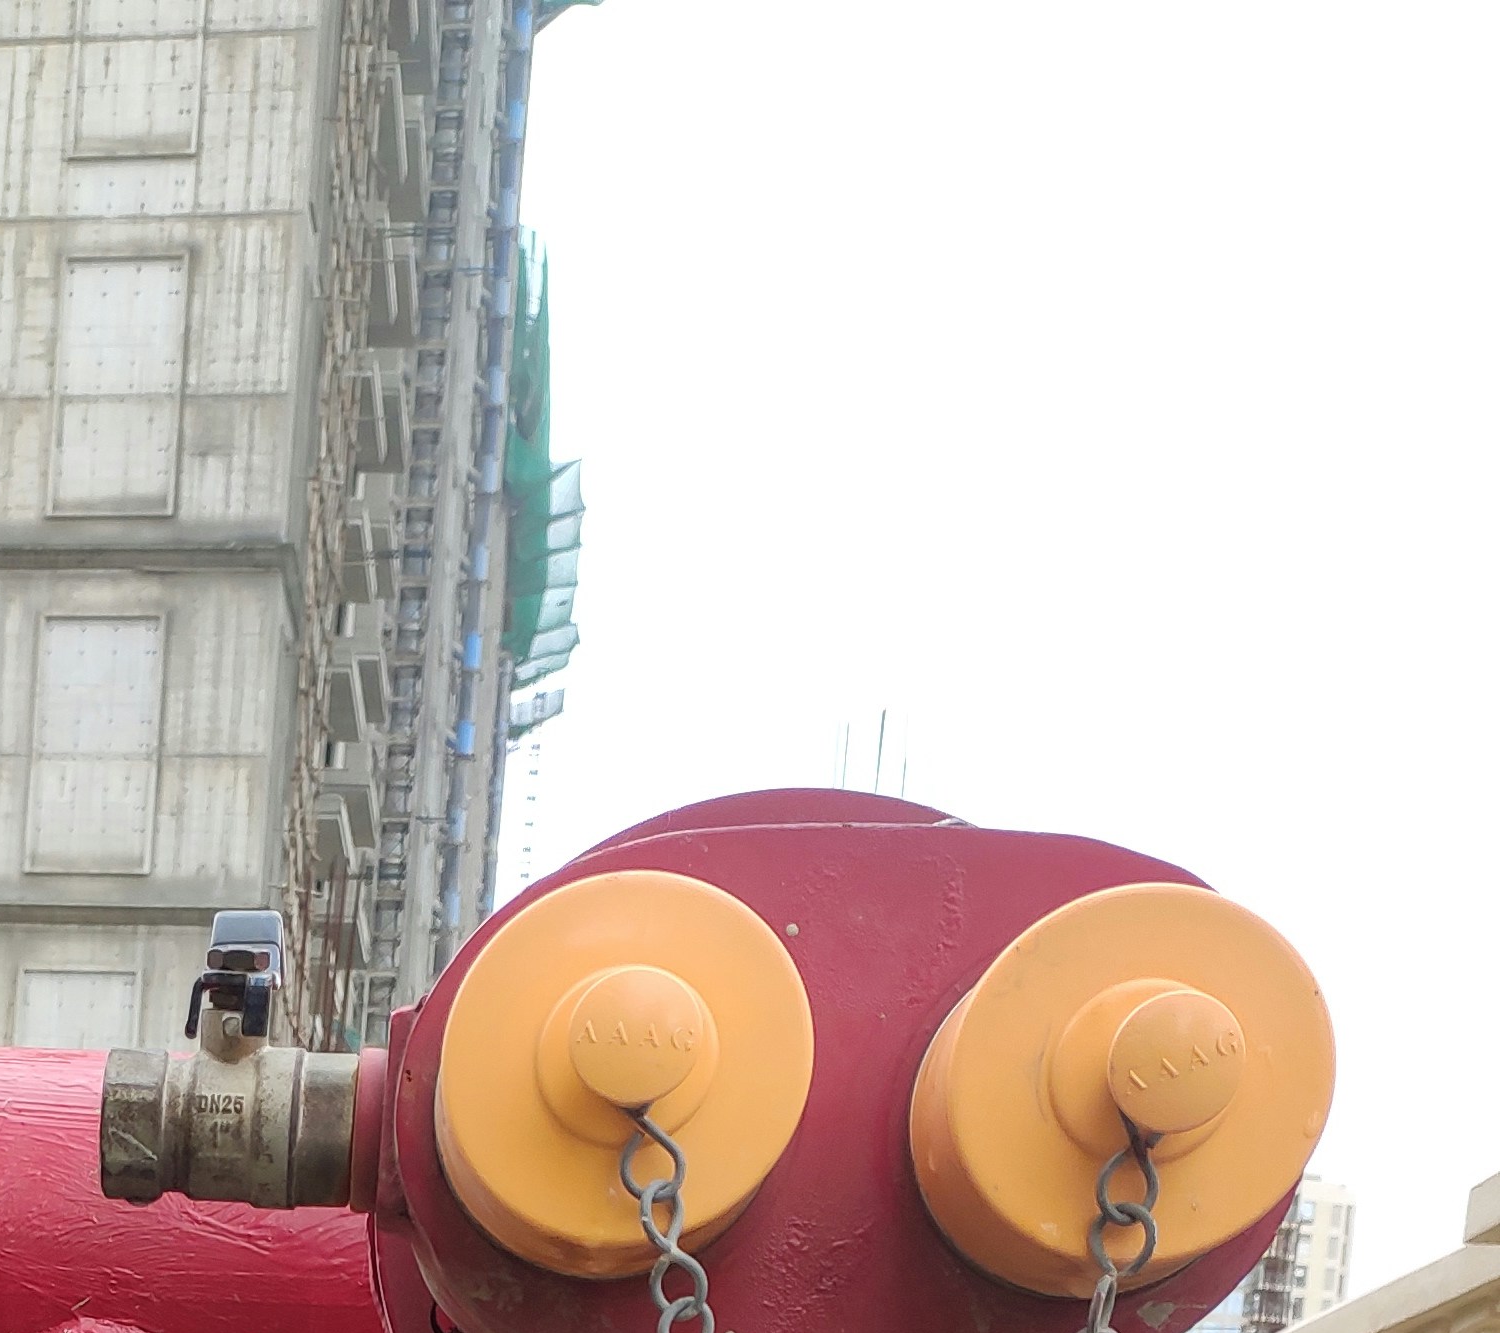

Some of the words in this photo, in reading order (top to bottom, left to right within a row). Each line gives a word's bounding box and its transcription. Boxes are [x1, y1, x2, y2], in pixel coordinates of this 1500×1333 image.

[576, 1019, 696, 1053] AAAG
[1126, 1030, 1238, 1096] AAAG
[196, 1094, 245, 1115] DN25
